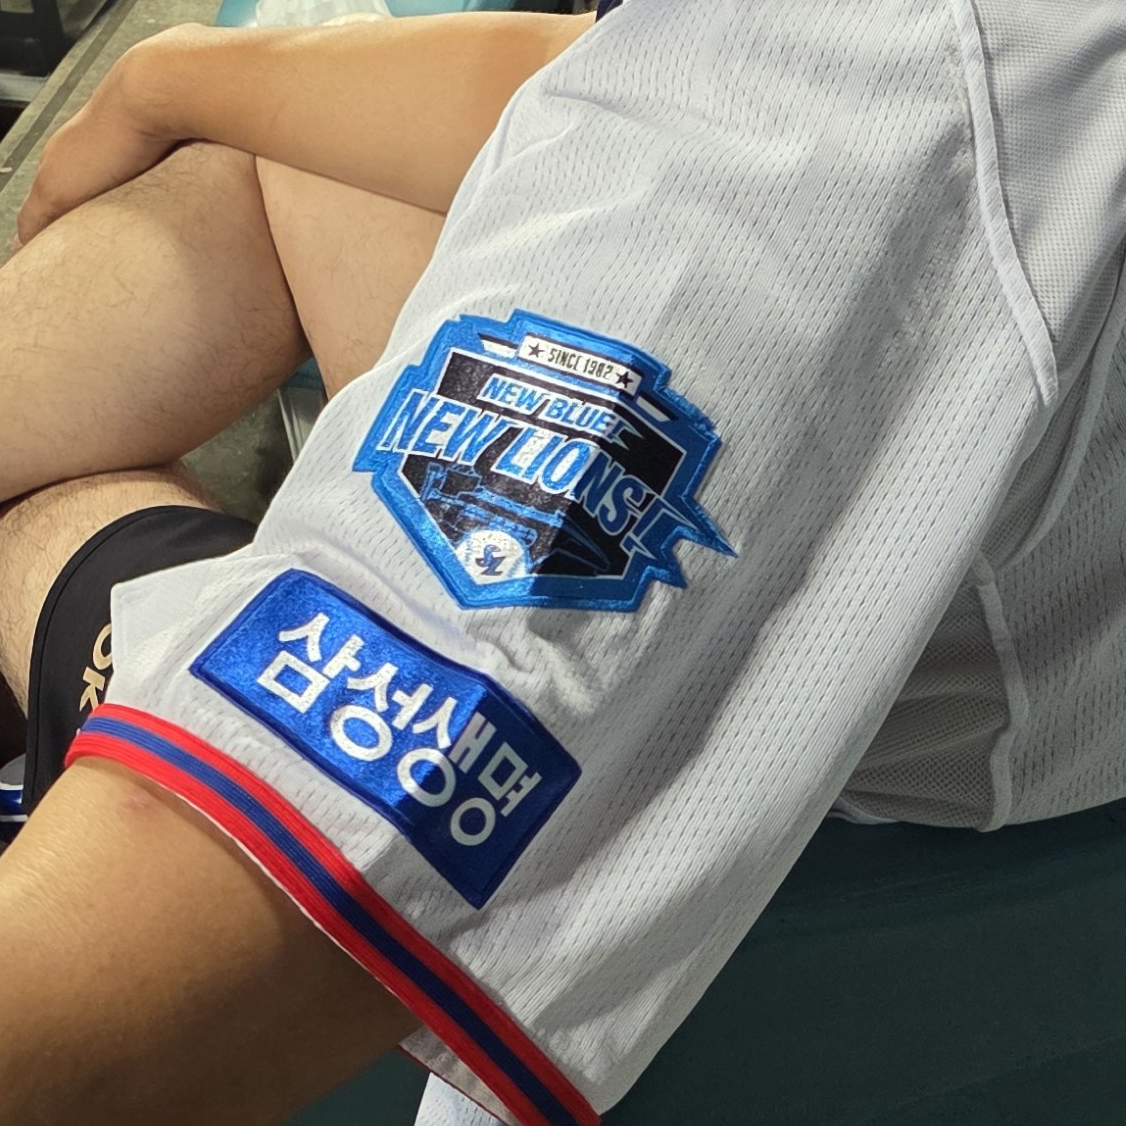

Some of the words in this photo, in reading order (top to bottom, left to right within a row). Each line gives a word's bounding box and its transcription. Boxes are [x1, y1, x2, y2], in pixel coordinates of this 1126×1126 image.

[547, 348, 583, 371] SINCE
[583, 358, 614, 379] 1982
[481, 377, 551, 411] NEW
[376, 389, 519, 467] NEW
[256, 612, 543, 846] 삼성생명
